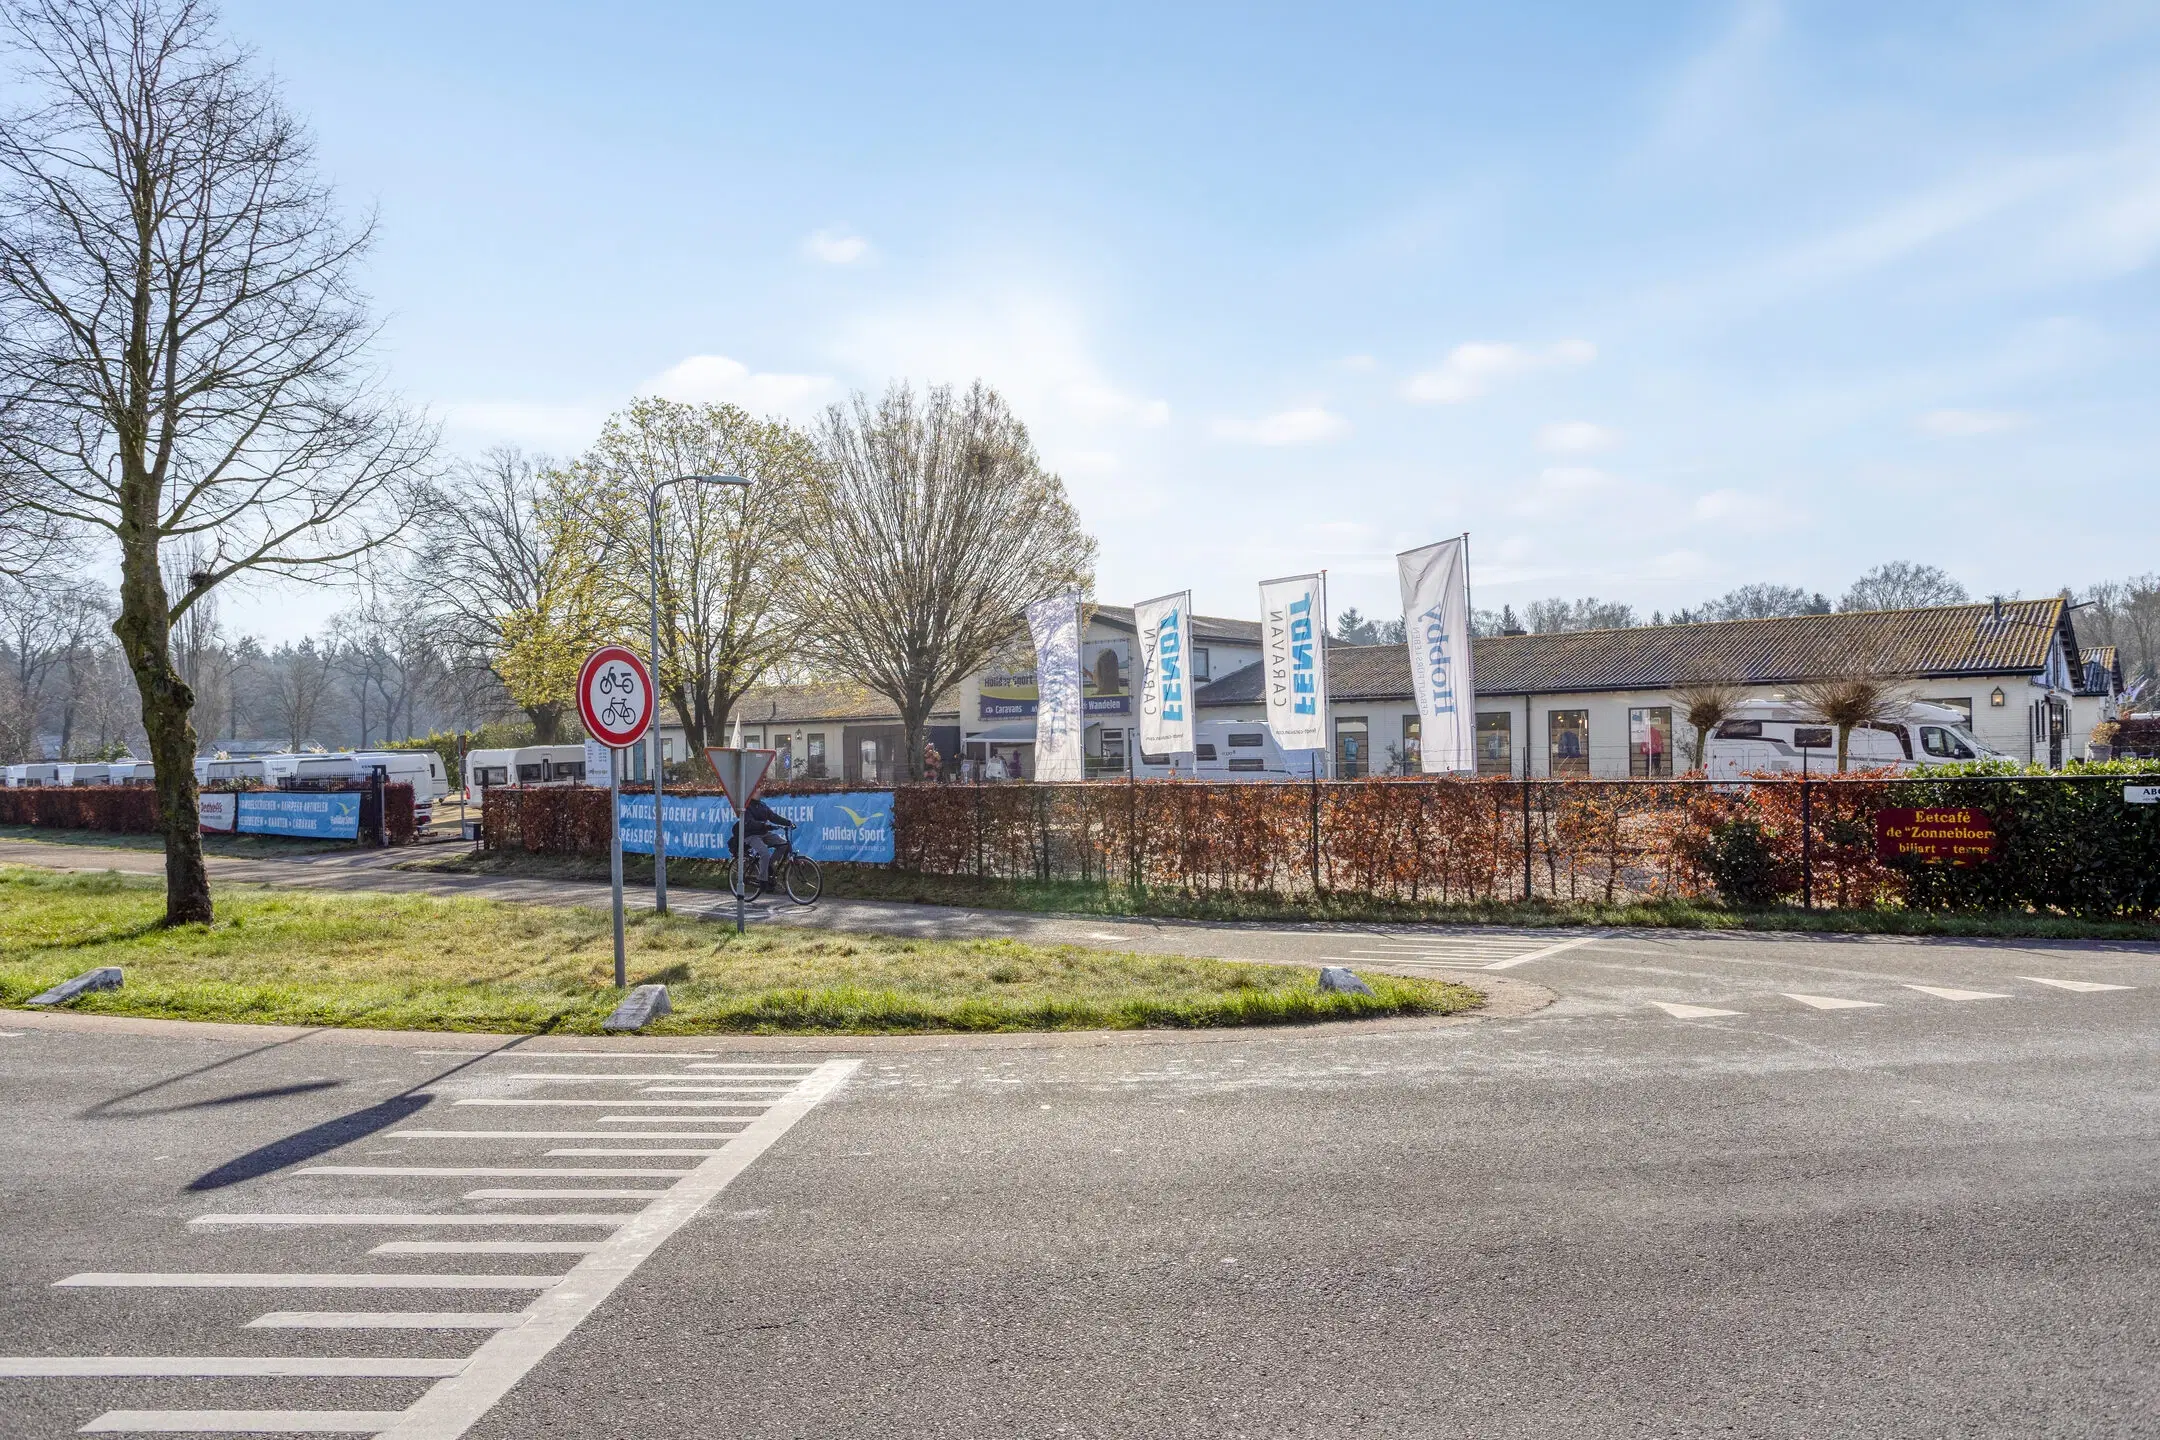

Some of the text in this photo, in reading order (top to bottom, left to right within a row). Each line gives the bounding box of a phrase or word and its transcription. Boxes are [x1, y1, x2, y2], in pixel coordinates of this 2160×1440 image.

[1013, 675, 1033, 688] Sport
[995, 699, 1121, 714] Caravans Wandelen
[620, 804, 698, 823] WANDELSHOENEN
[1915, 810, 1971, 823] Eetcafé
[822, 826, 886, 844] Holiday Sport
[1886, 826, 1902, 838] de
[682, 832, 724, 849] KAARTEN
[1899, 842, 1936, 854] biljart
